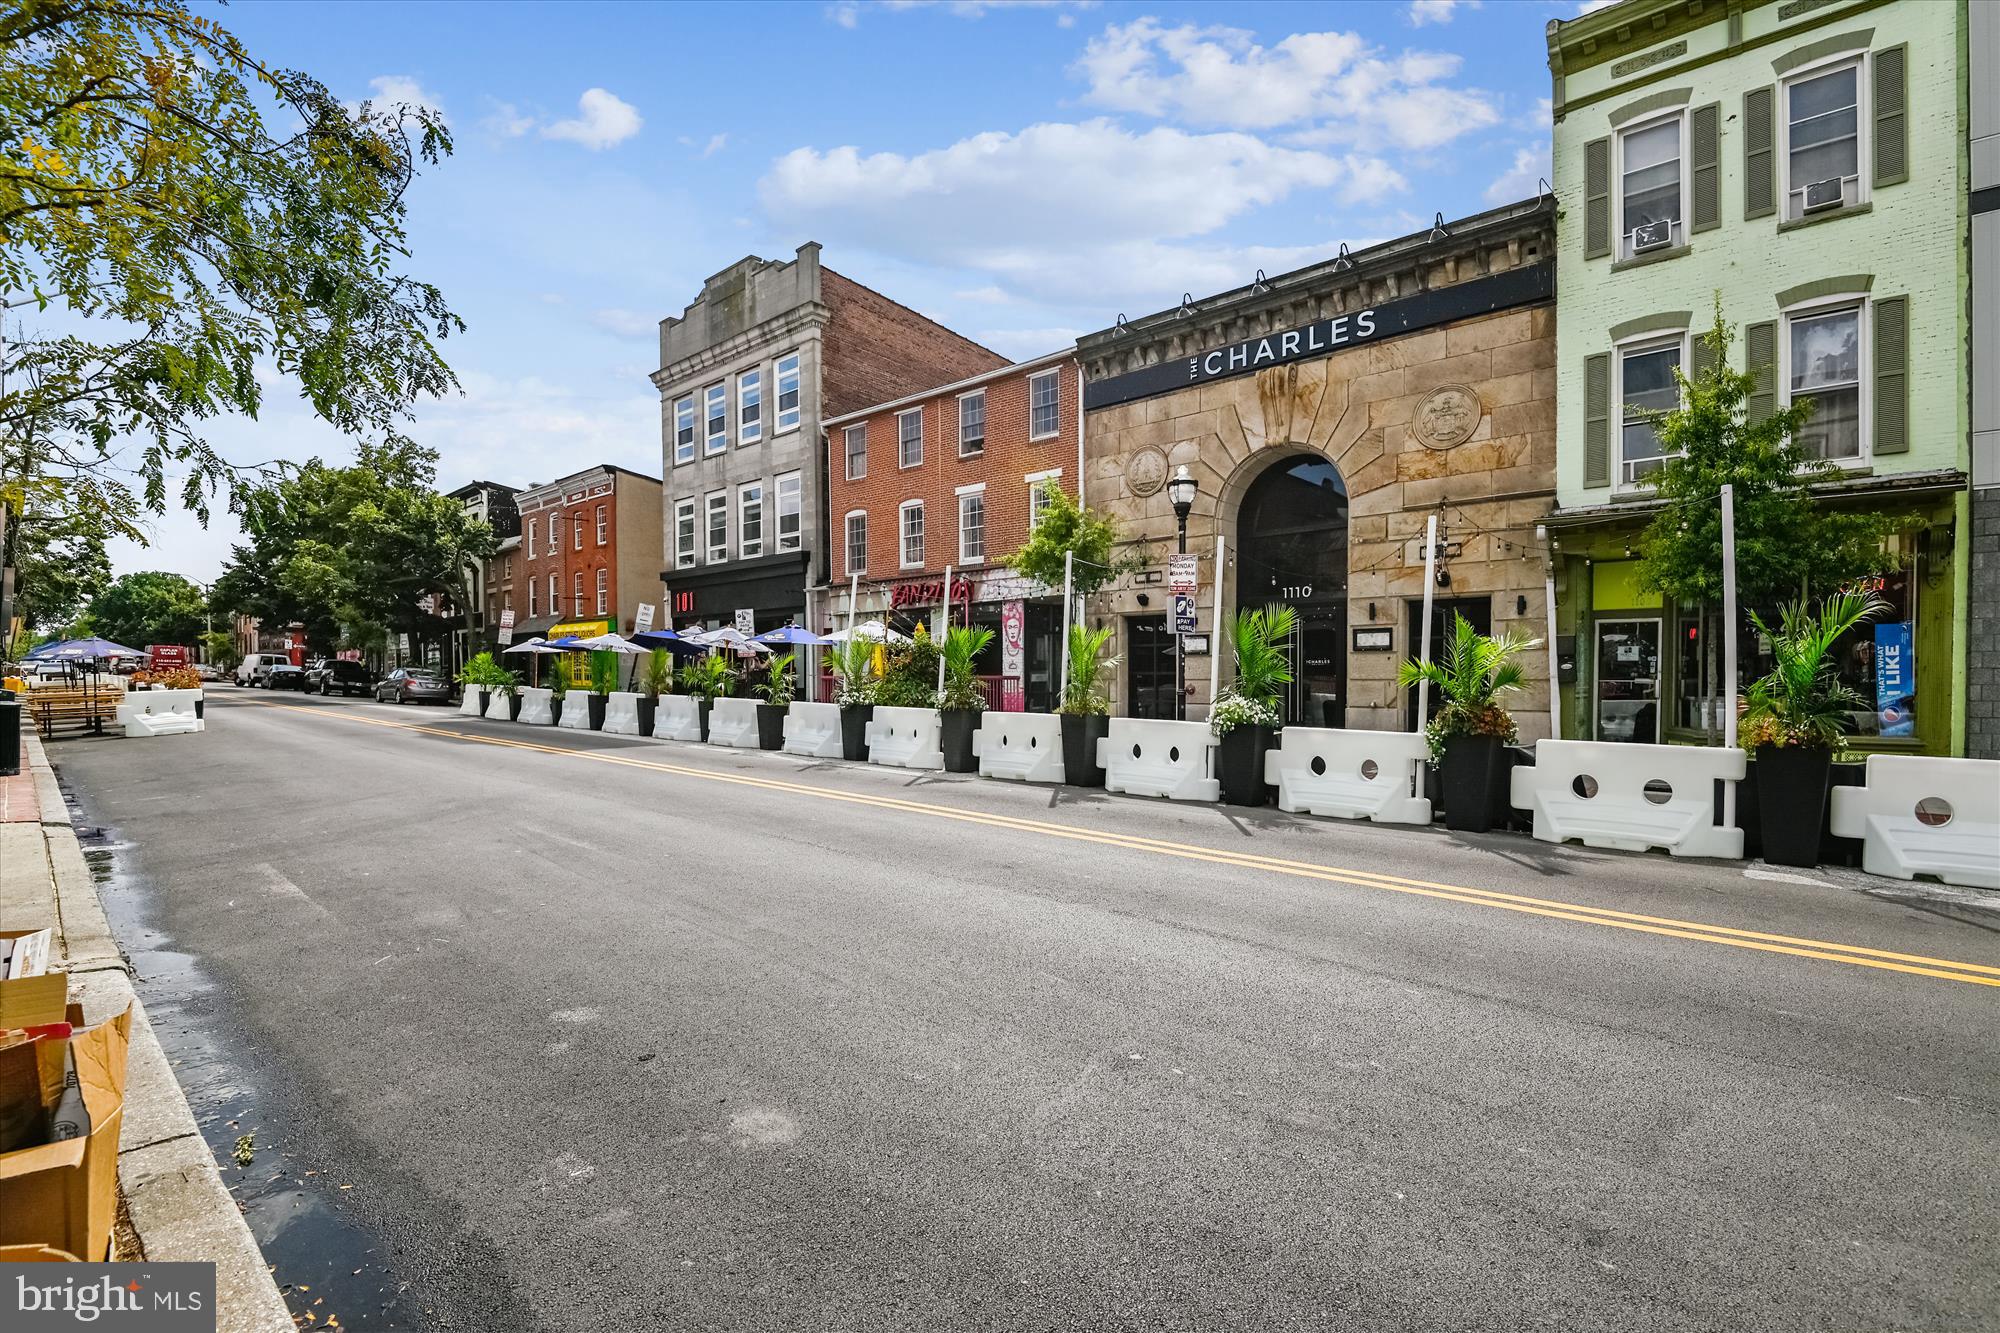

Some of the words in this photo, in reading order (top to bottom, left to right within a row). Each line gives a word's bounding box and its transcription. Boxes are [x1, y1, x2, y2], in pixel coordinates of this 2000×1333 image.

[1190, 357, 1198, 380] THE
[1204, 310, 1376, 375] CHARLES
[676, 591, 693, 612] 101
[1283, 586, 1312, 599] 1110
[1877, 646, 1885, 669] WHAT
[1885, 644, 1901, 685] LIKE
[1878, 670, 1886, 696] THAT'S
